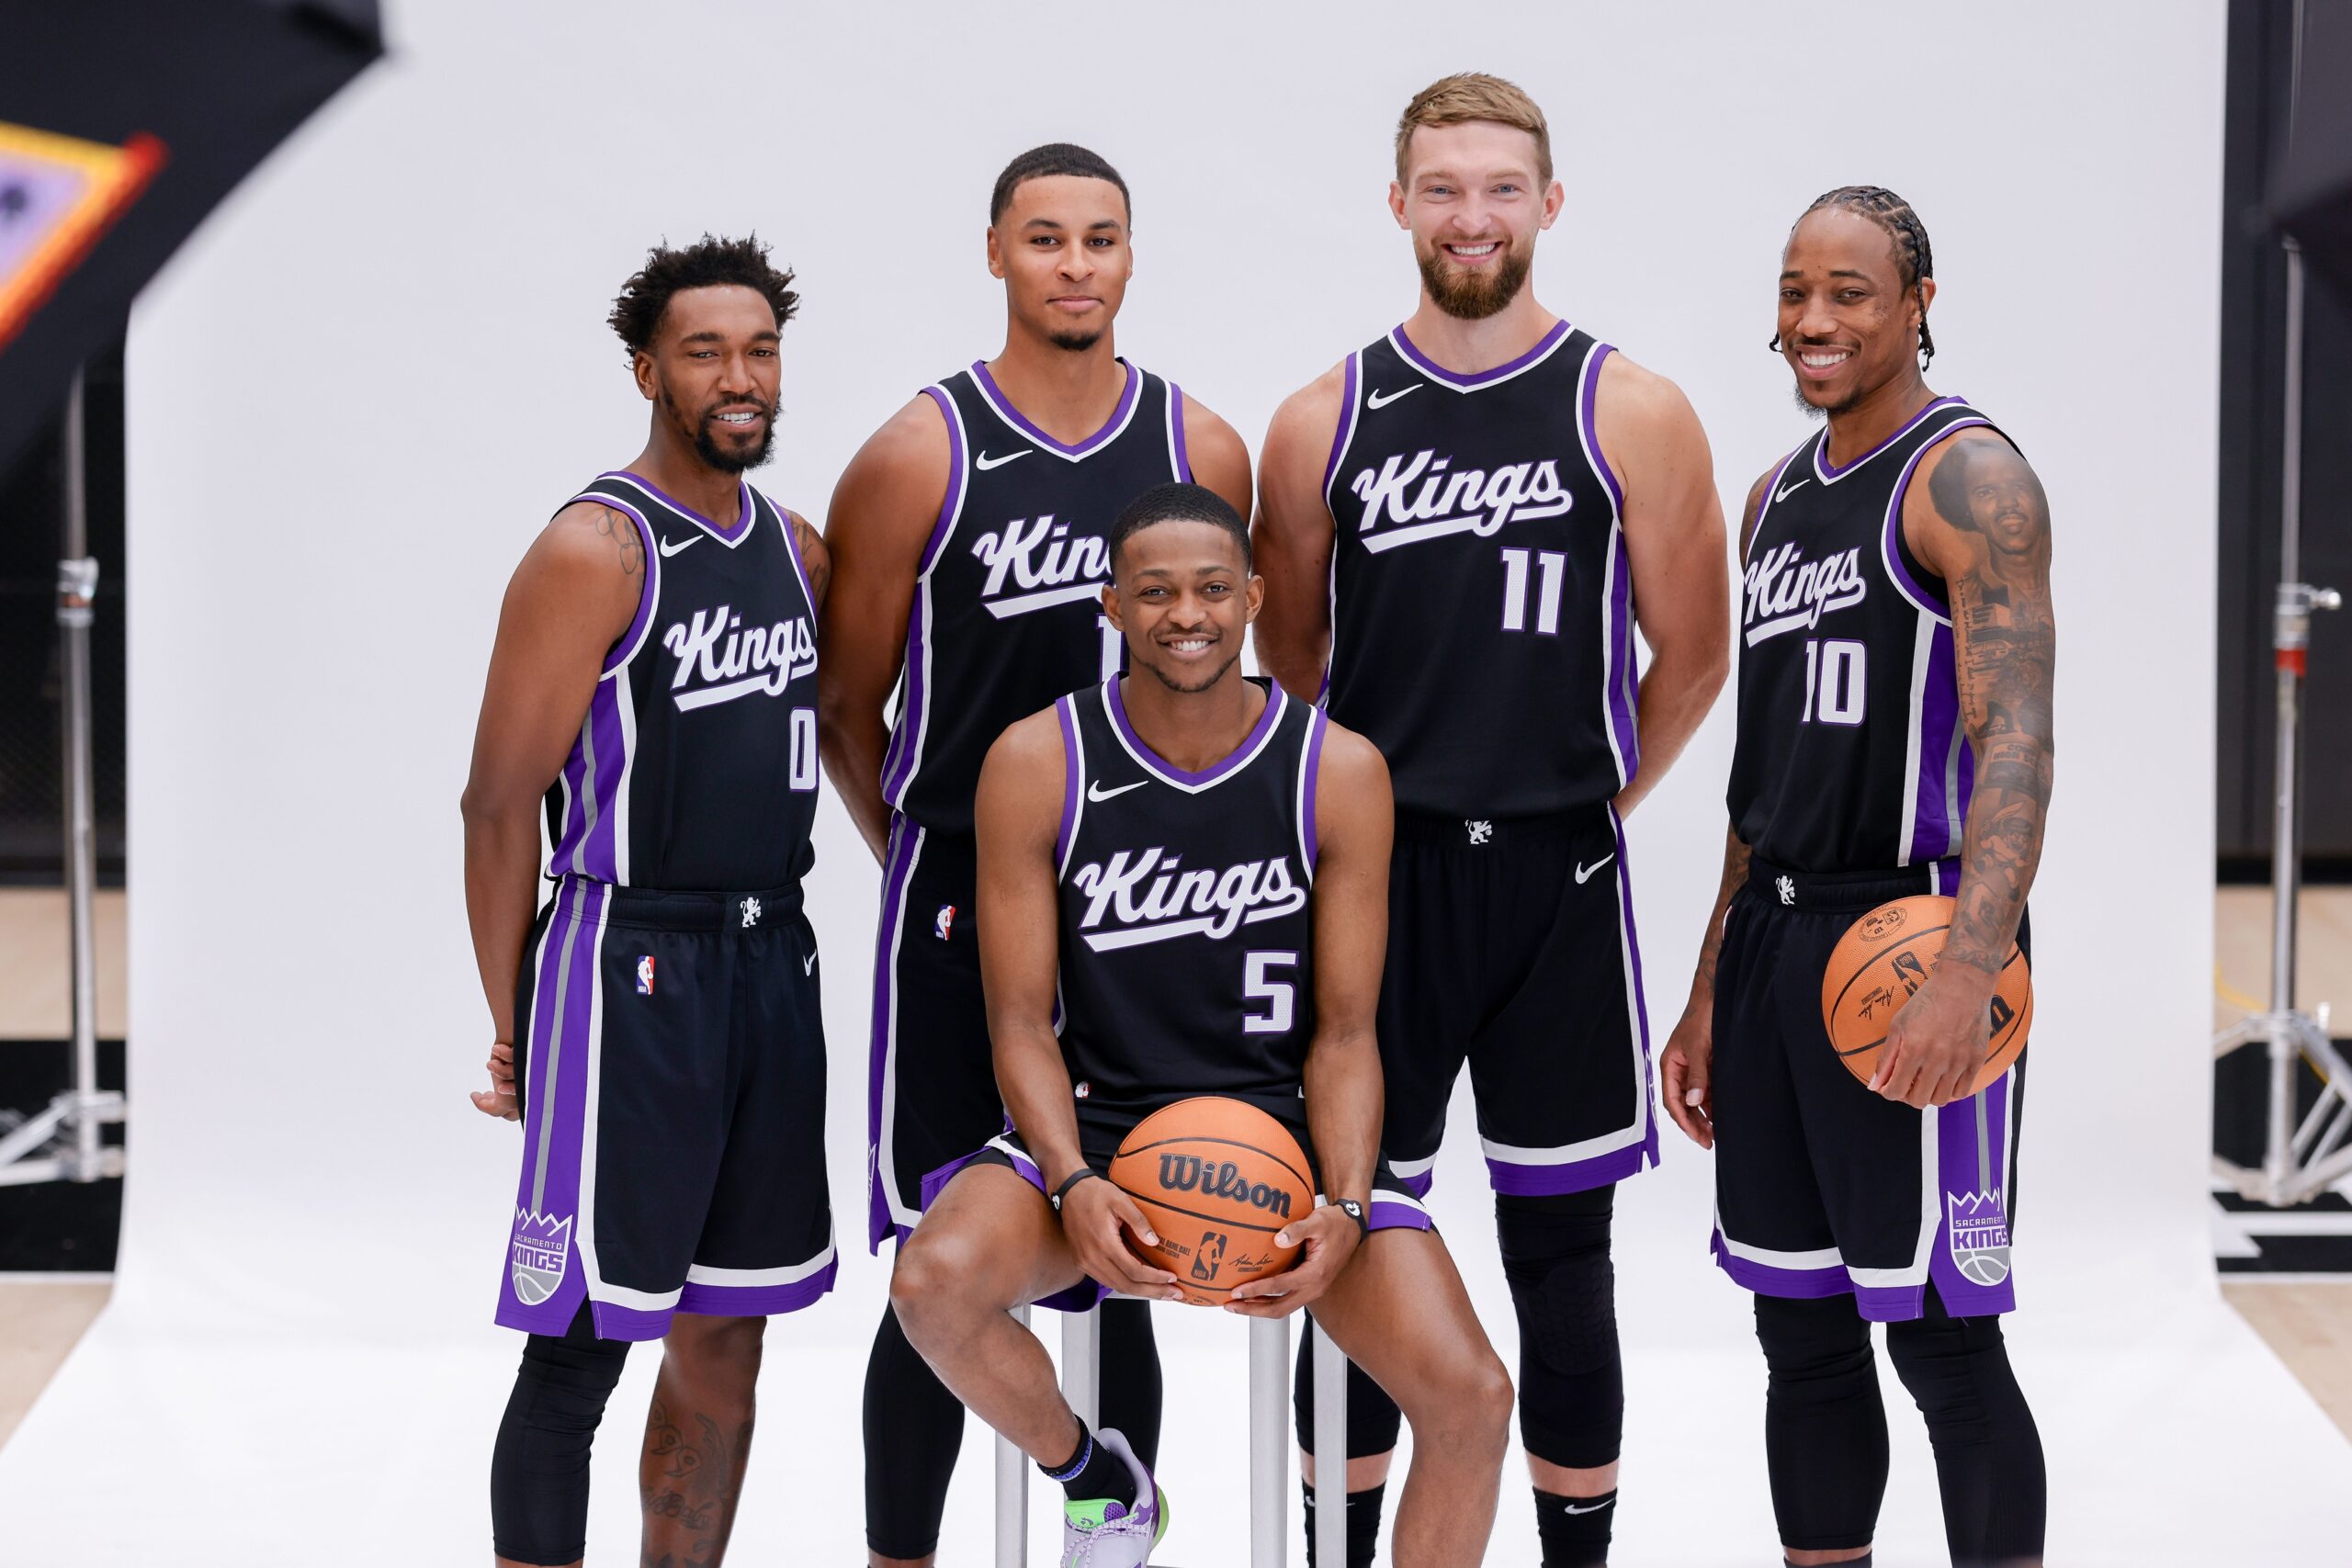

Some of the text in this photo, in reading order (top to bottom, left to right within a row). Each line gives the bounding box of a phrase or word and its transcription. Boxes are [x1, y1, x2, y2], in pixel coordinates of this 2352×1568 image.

[1351, 448, 1574, 554] Kings
[972, 513, 1112, 621] Kin
[1499, 547, 1567, 636] 11
[1744, 540, 1867, 649] Kings
[662, 604, 818, 713] Kings
[1802, 637, 1867, 727] 10
[789, 706, 818, 792] 0
[1073, 846, 1306, 953] Kings
[1242, 950, 1299, 1035] 5
[1159, 1153, 1292, 1220] Wilson
[513, 1244, 564, 1273] KINGS
[514, 1233, 562, 1250] SACRAMENTO
[1953, 1228, 2009, 1250] KINGS
